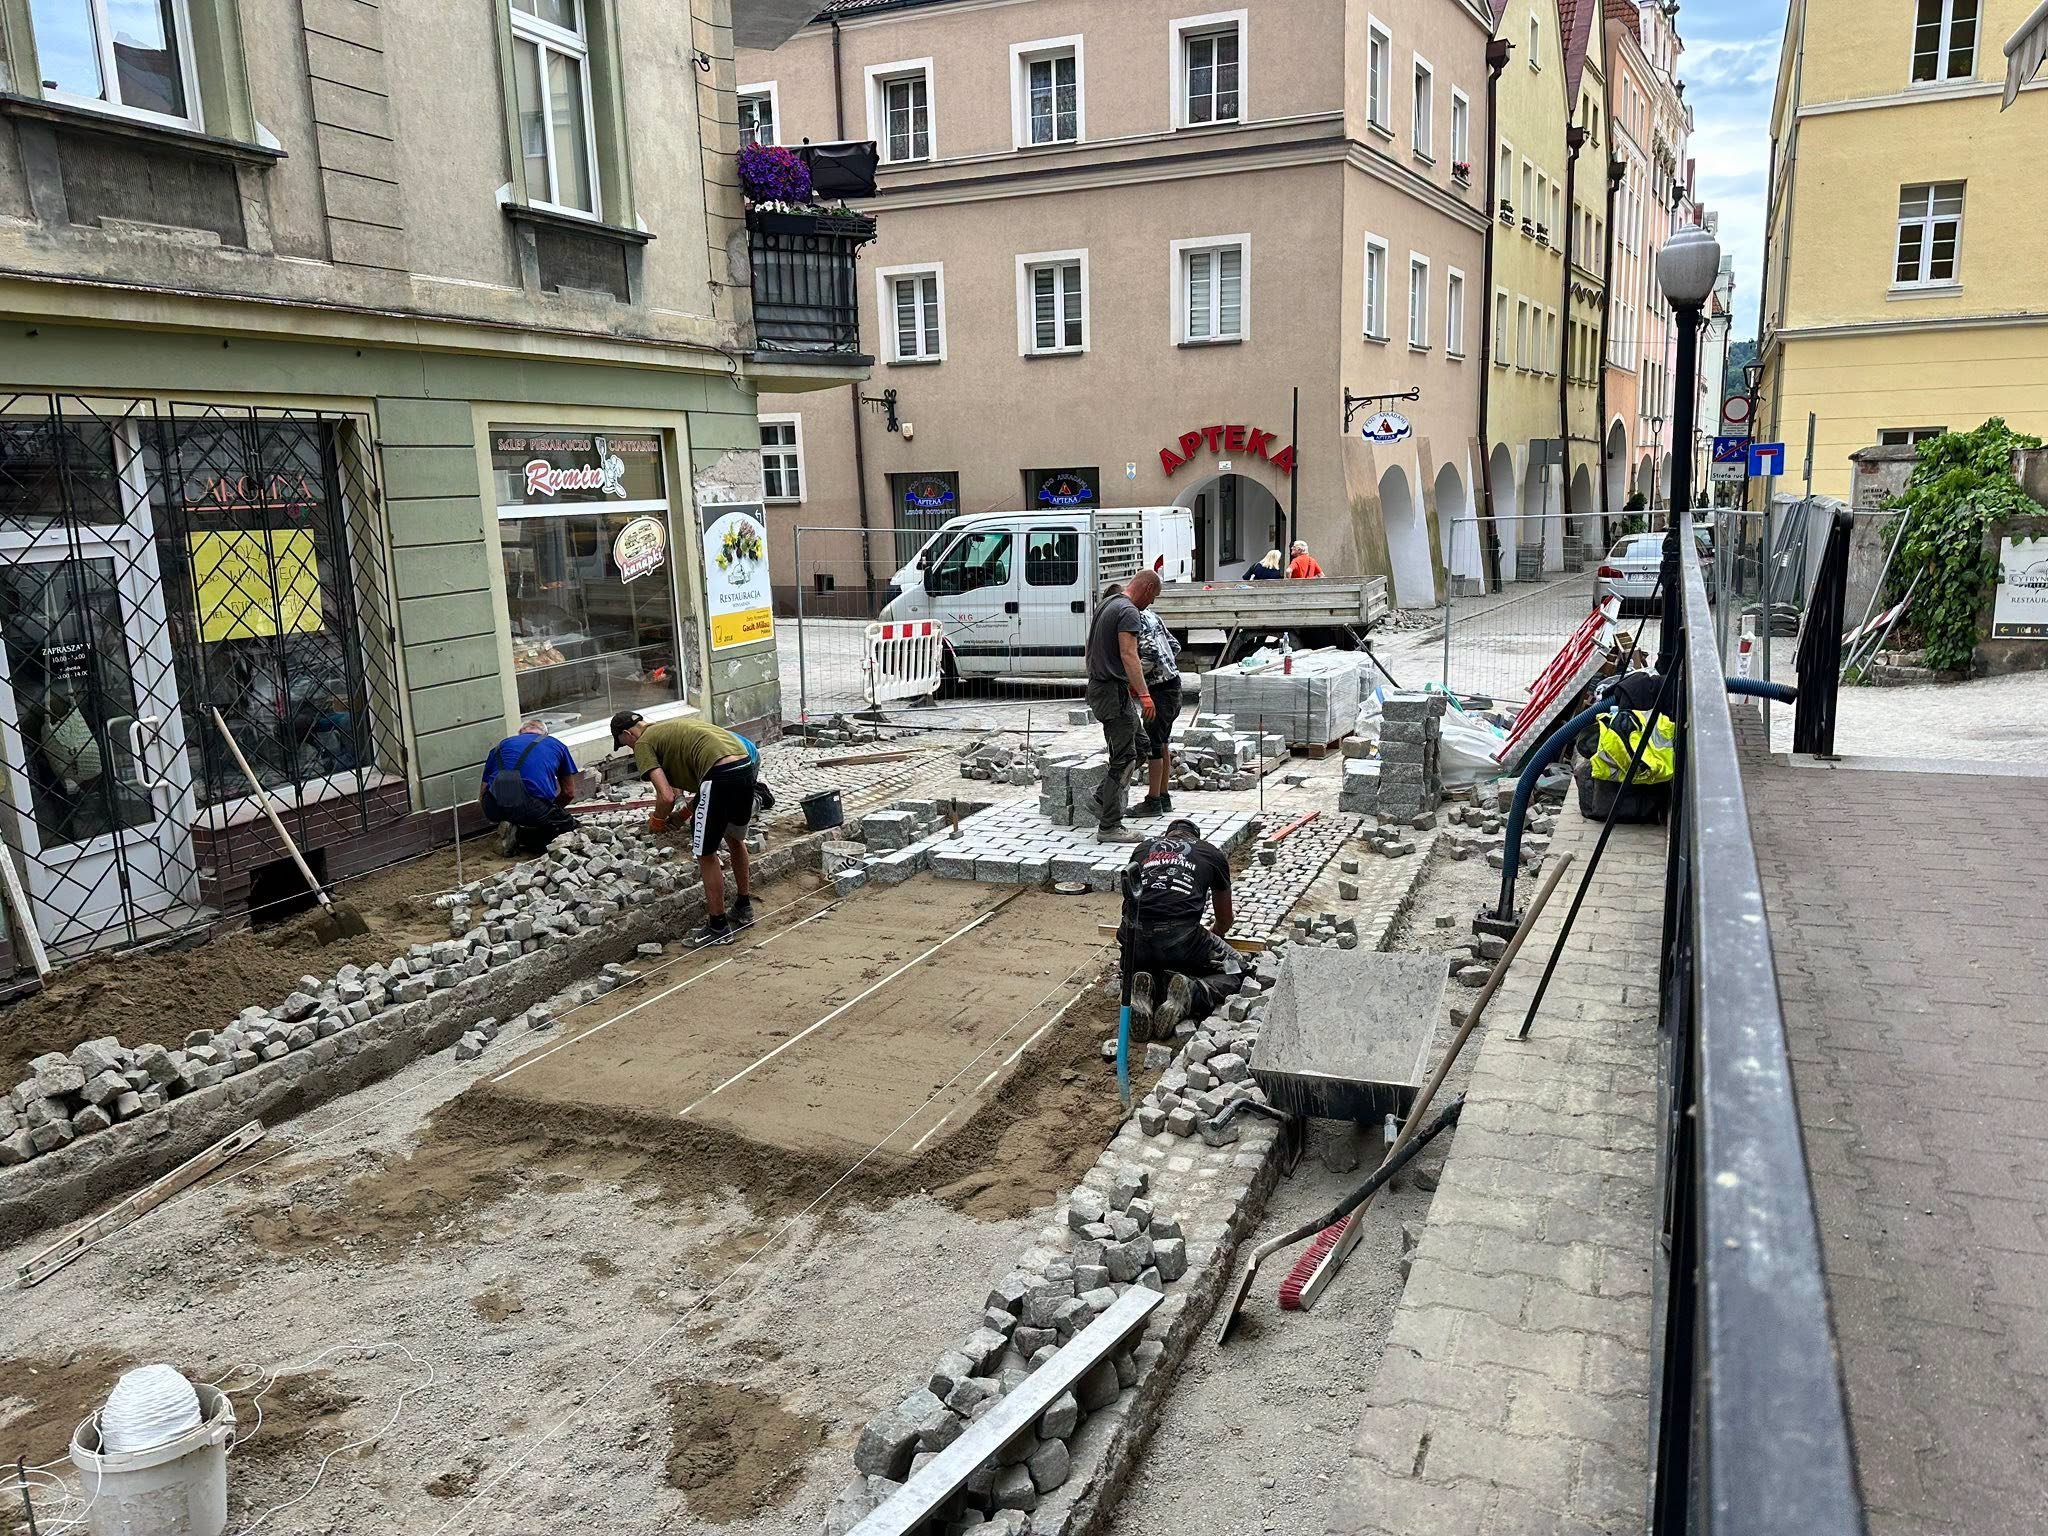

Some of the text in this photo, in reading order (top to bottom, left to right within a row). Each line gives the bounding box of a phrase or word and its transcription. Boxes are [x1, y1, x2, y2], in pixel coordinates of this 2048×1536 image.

[498, 438, 526, 451] SKLEP
[1158, 424, 1294, 477] APTEKA
[526, 459, 605, 496] Rumin
[1052, 496, 1078, 504] APTEKA
[622, 549, 663, 579] kanapki
[2011, 575, 2048, 583] CYTRYN
[720, 591, 760, 603] RESTAURACJA
[958, 613, 974, 622] KLG
[42, 643, 91, 656] ZAPRASZAY
